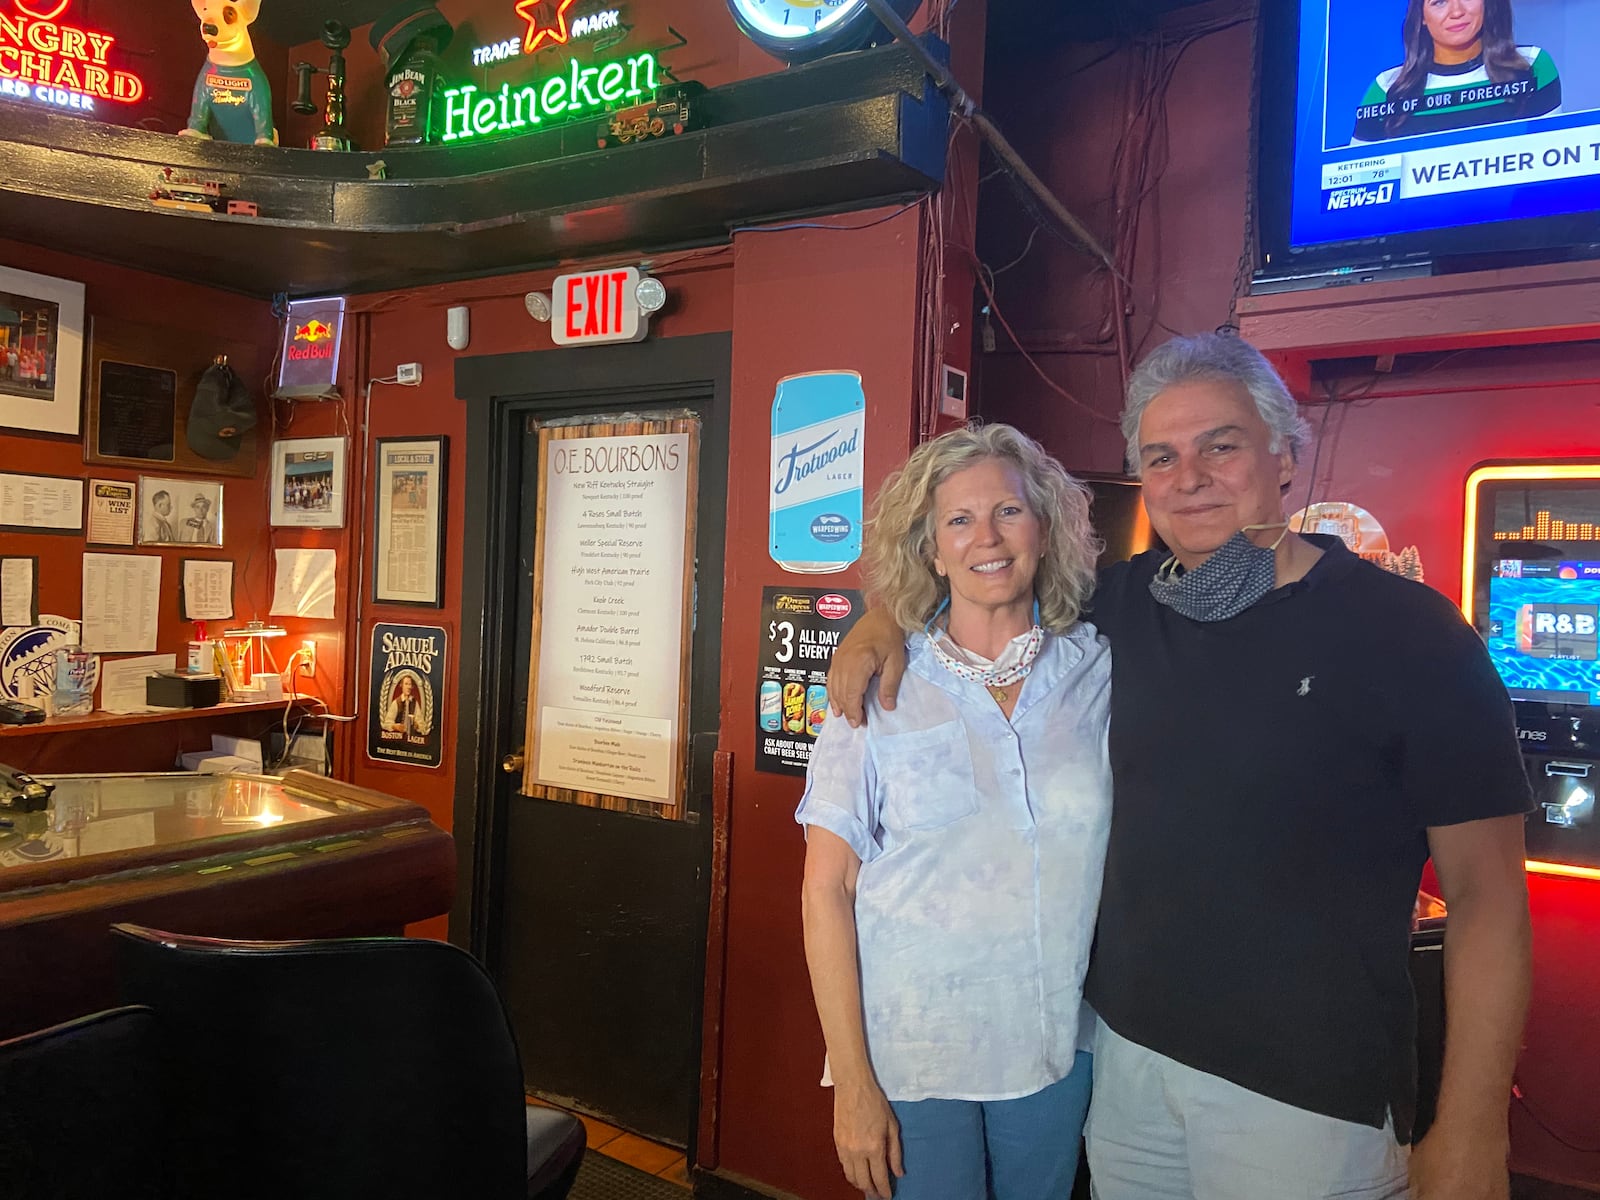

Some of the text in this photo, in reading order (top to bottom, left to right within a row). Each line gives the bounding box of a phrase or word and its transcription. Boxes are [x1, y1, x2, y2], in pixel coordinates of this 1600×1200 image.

[0, 12, 115, 65] NGRY
[472, 10, 619, 66] TRADE MARK
[0, 46, 143, 102] CHARD
[209, 76, 224, 85] BUD
[389, 68, 425, 88] JIM BEAM
[0, 78, 95, 111] RD CIDER
[442, 53, 660, 141] Heineken
[1356, 80, 1535, 120] CHECK OF OUR FORECAST.
[1337, 158, 1386, 171] KETTERING
[1411, 142, 1600, 185] WEATHER ON T
[1328, 174, 1353, 185] 12:01
[565, 271, 628, 338] EXIT
[288, 342, 334, 361] Red Bull
[584, 443, 680, 474] BOURBONS
[774, 428, 858, 494] Trotwood
[600, 480, 626, 489] Kentucky
[626, 480, 654, 490] Straight
[108, 500, 132, 508] WINE
[588, 509, 605, 518] Roses
[606, 509, 622, 518] Small
[623, 509, 642, 518] Batch
[597, 538, 618, 548] Special
[618, 538, 644, 548] Reserve
[601, 566, 628, 576] American
[629, 568, 650, 576] Prairie
[608, 596, 625, 605] Creek
[600, 625, 619, 634] Double
[619, 626, 640, 635] Barrel
[1535, 612, 1596, 635] R&B
[382, 632, 439, 657] SAMUEL
[769, 620, 794, 663] $3
[799, 629, 840, 646] ALL DAY
[580, 654, 633, 666] 1792 Small Batch
[798, 644, 830, 660] EVERY
[384, 652, 432, 674] ADAMS
[606, 685, 632, 695] Reserve
[381, 731, 426, 744] BOSTON LAGER
[1514, 727, 1548, 740] unes
[764, 738, 776, 748] ASK
[776, 739, 794, 750] ABOUT
[794, 741, 807, 750] OUR
[764, 746, 781, 756] CRAFT
[781, 748, 796, 758] BEER
